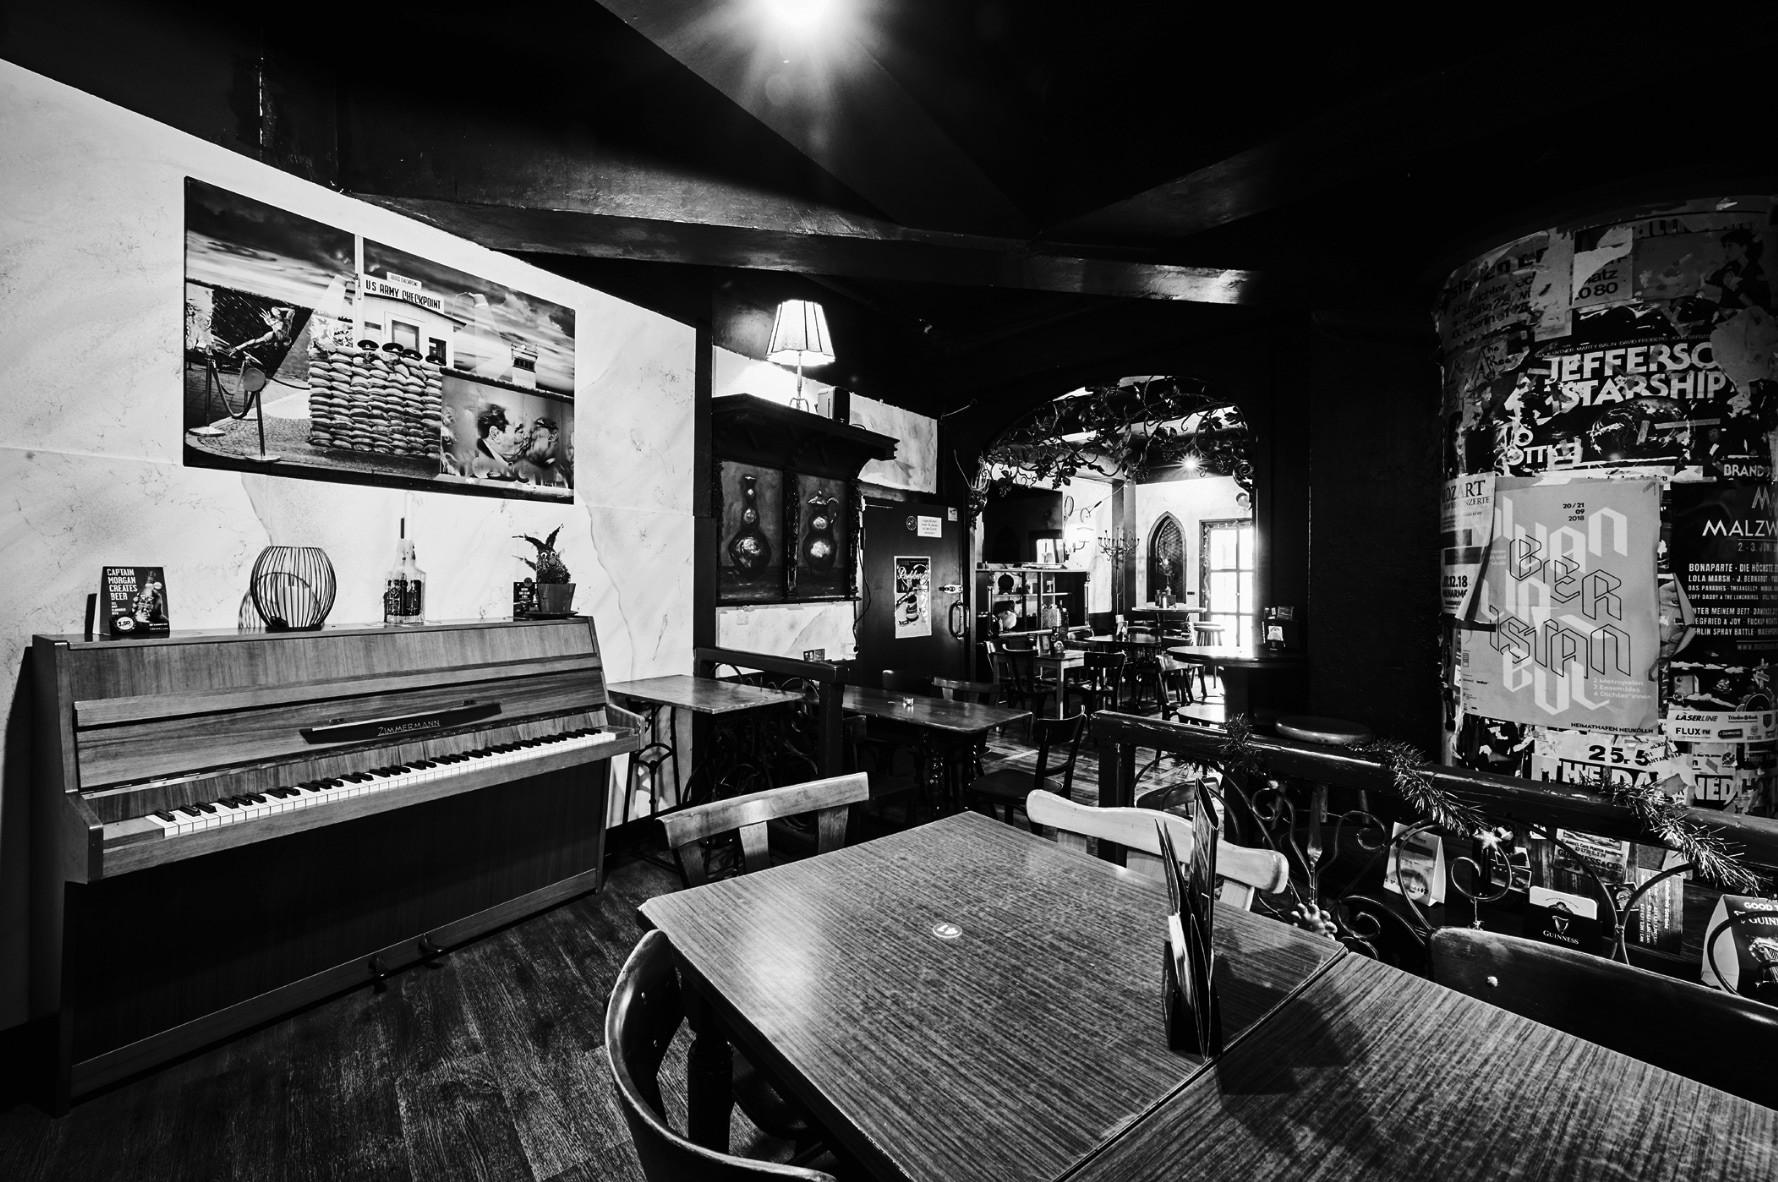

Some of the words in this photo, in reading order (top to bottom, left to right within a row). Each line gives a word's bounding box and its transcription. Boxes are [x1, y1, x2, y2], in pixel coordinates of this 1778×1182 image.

[365, 279, 377, 291] US
[379, 284, 399, 297] ARMY
[402, 290, 441, 309] CHECKPOINT
[1557, 370, 1726, 409] STARSHIP
[106, 568, 135, 576] CAPTAIN
[1688, 563, 1734, 573] BONAPARTE
[1739, 563, 1750, 573] DIE
[1688, 575, 1706, 583] LOLA
[1708, 575, 1732, 583] MARSH
[1711, 607, 1735, 616] MEINEM
[1694, 617, 1722, 626] EGFRIED
[1729, 617, 1742, 626] JOY
[1695, 627, 1711, 636] RLIN
[1713, 627, 1733, 636] SPRAY
[1734, 627, 1754, 637] BATTLE
[377, 720, 441, 737] ZIMMERMANN
[1570, 722, 1618, 732] HEIMATHAFEN
[1675, 727, 1701, 735] FLUX
[1744, 902, 1774, 912] GOOD
[1542, 929, 1580, 945] GUINNESS
